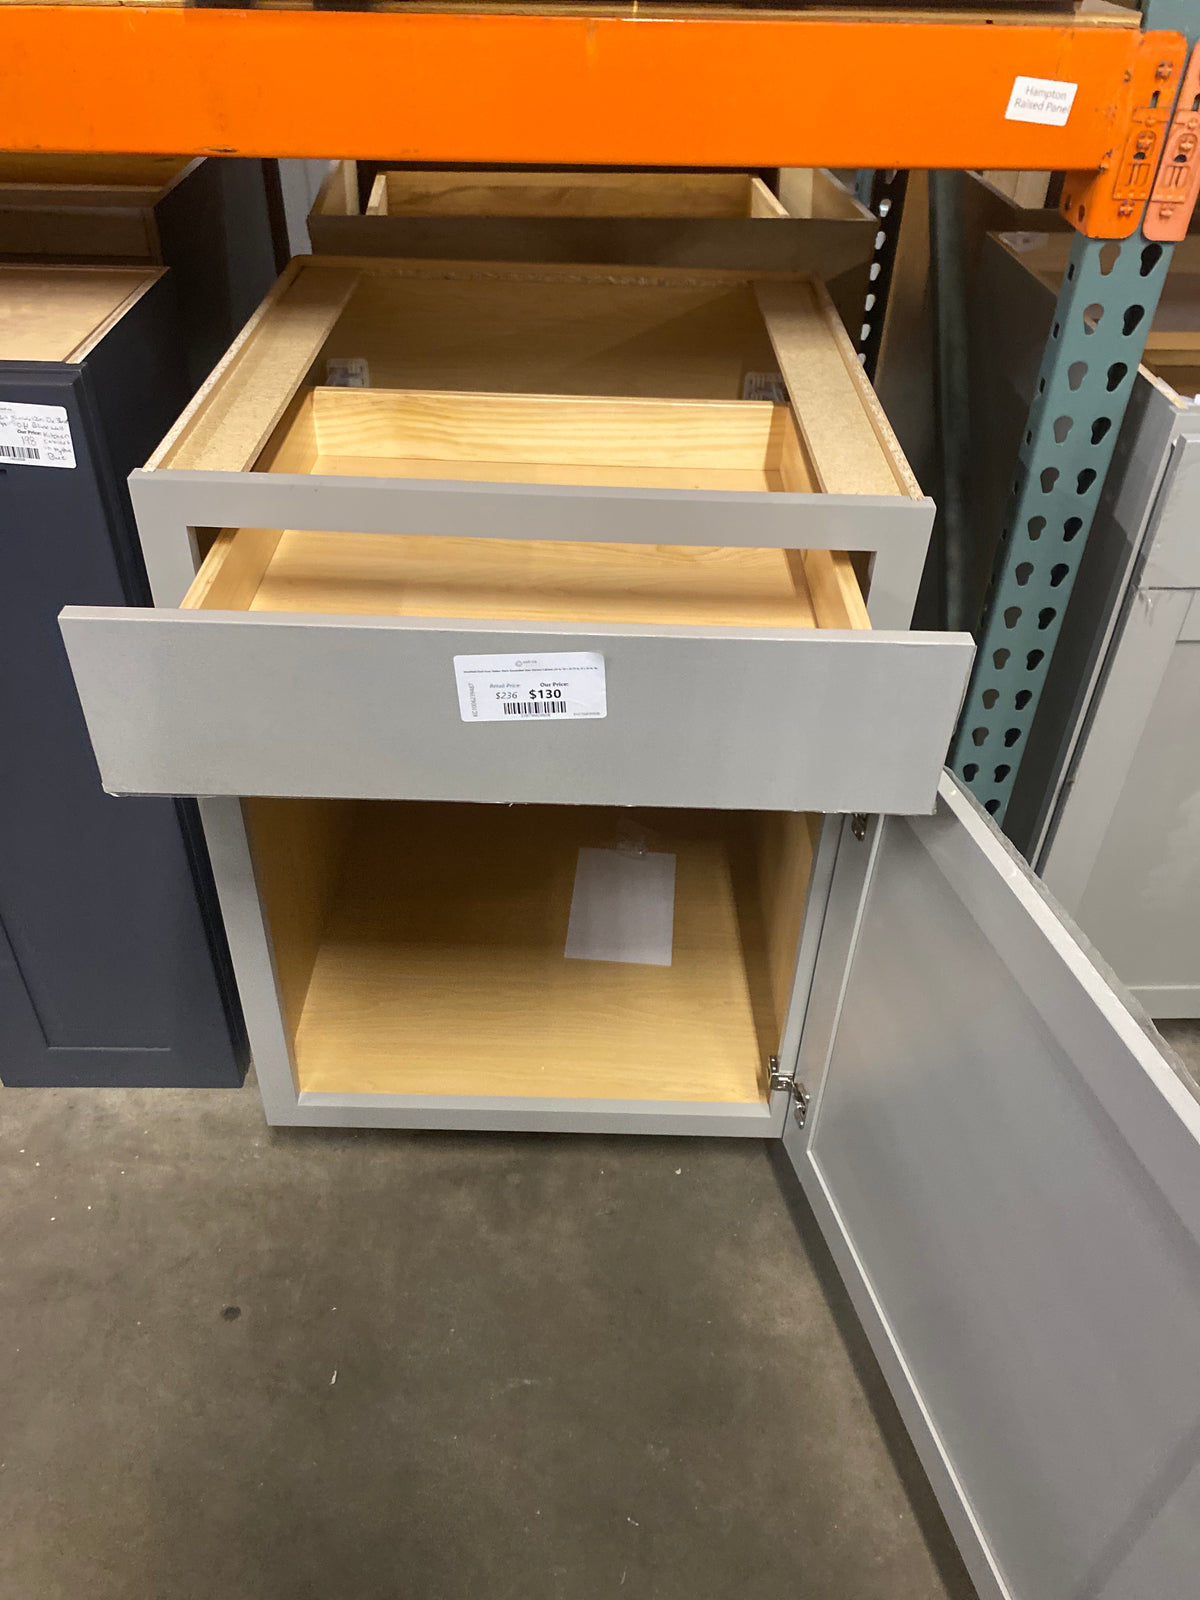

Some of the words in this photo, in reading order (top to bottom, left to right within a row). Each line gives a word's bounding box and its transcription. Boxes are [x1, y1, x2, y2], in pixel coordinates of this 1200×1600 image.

[1025, 85, 1067, 100] Hampton
[1014, 97, 1045, 112] Raised
[495, 691, 518, 700] $236
[528, 689, 562, 700] $130
